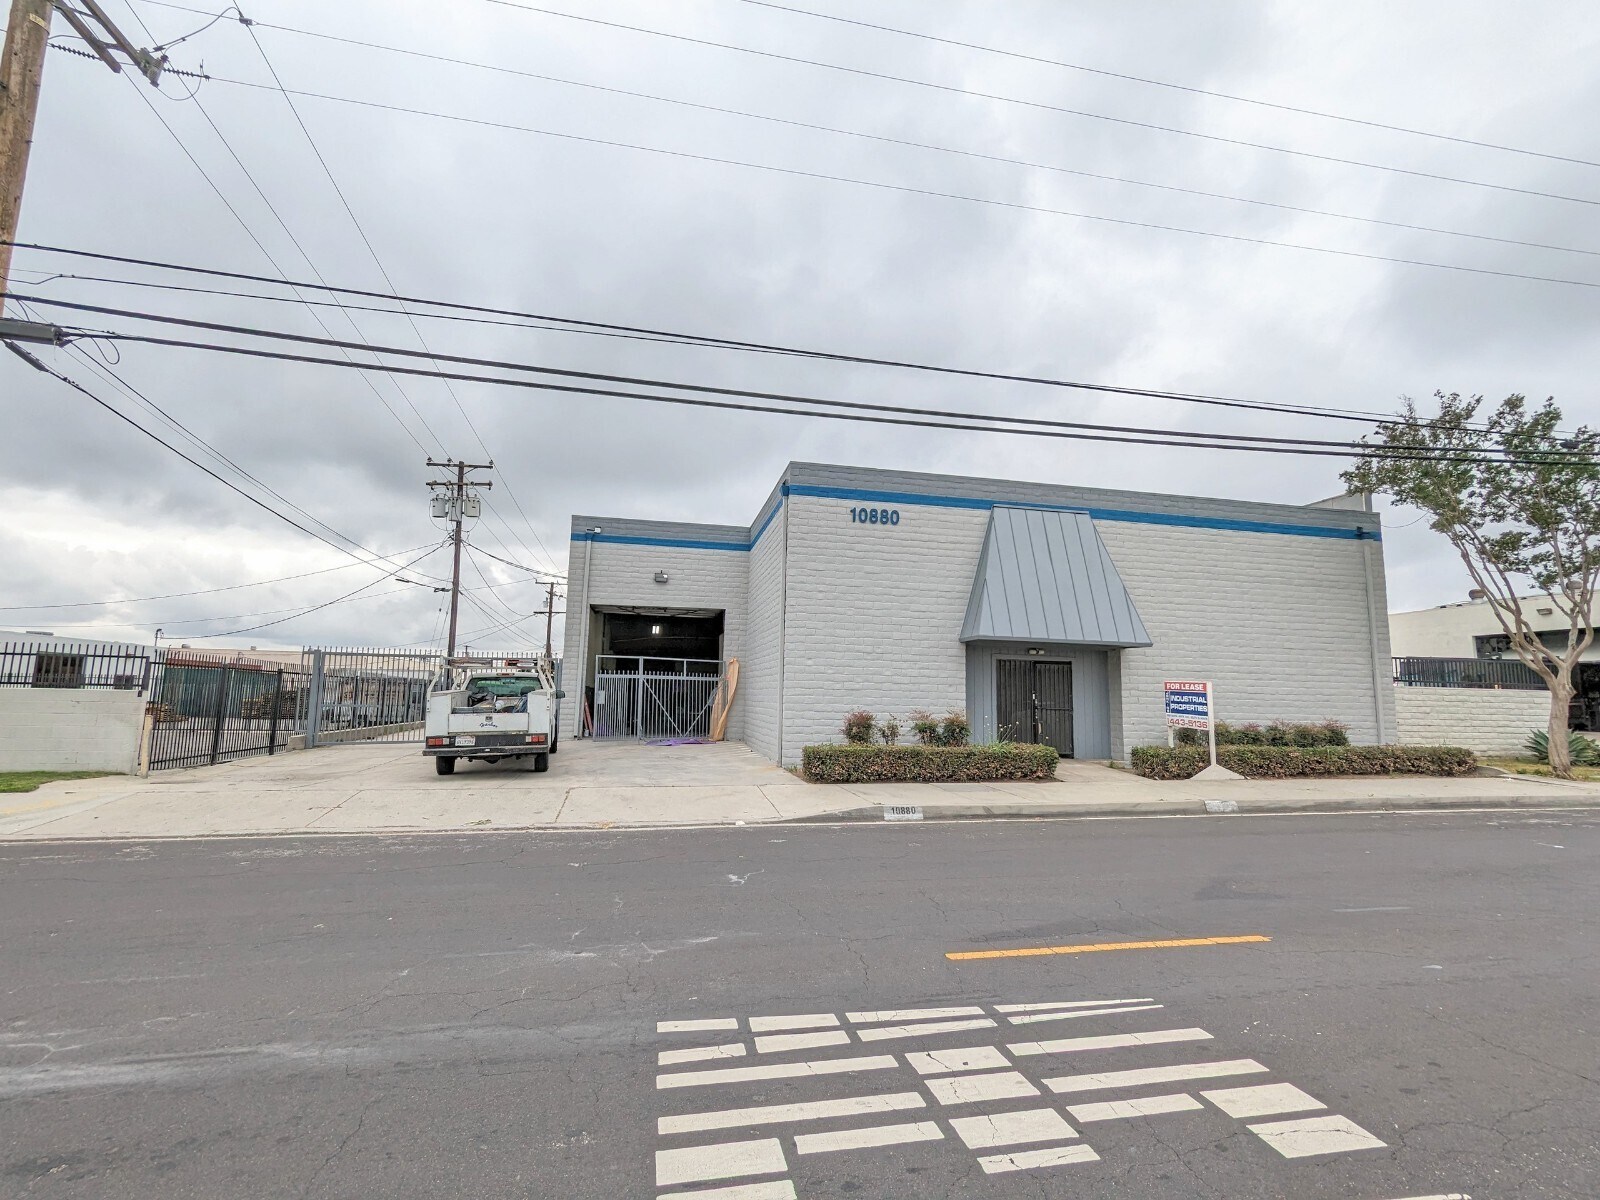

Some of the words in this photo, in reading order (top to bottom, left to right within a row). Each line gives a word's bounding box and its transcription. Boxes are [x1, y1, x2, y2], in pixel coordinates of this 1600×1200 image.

[850, 506, 900, 526] 10880
[1181, 683, 1204, 691] LEASE
[1170, 695, 1207, 703] INDUSTRIAL
[1170, 703, 1208, 712] PROPERTIES
[891, 806, 916, 815] 10880
[655, 998, 1474, 1200] AHE
